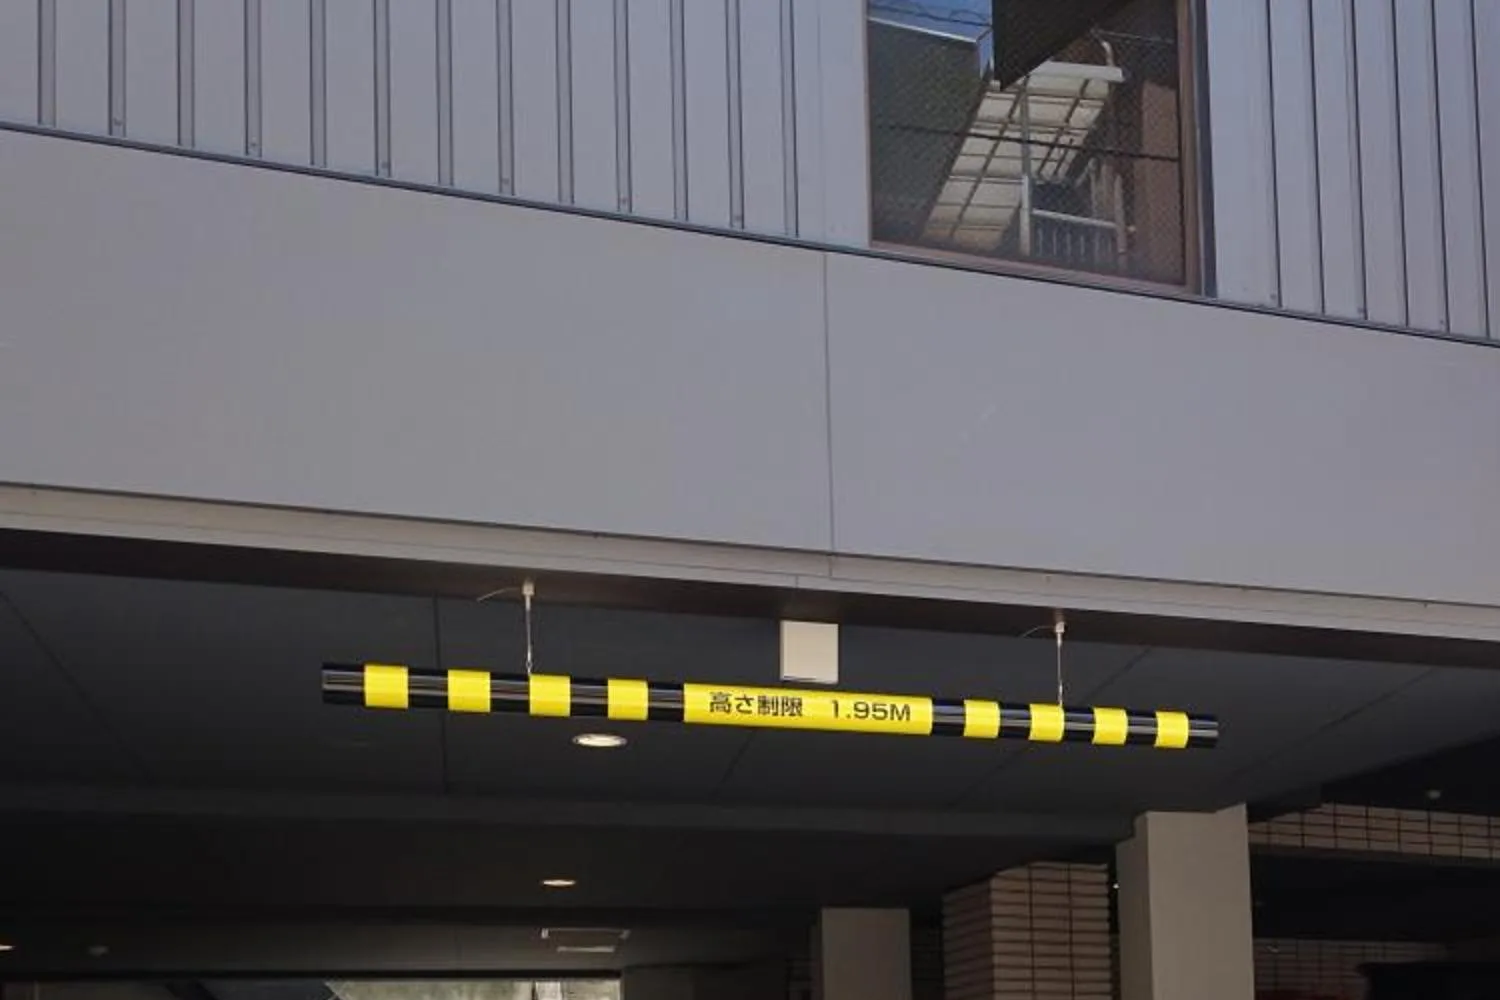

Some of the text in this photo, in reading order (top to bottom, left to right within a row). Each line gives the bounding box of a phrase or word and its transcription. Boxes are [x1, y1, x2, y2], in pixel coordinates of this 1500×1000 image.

[709, 691, 911, 722] 高さ制限 1.95M
